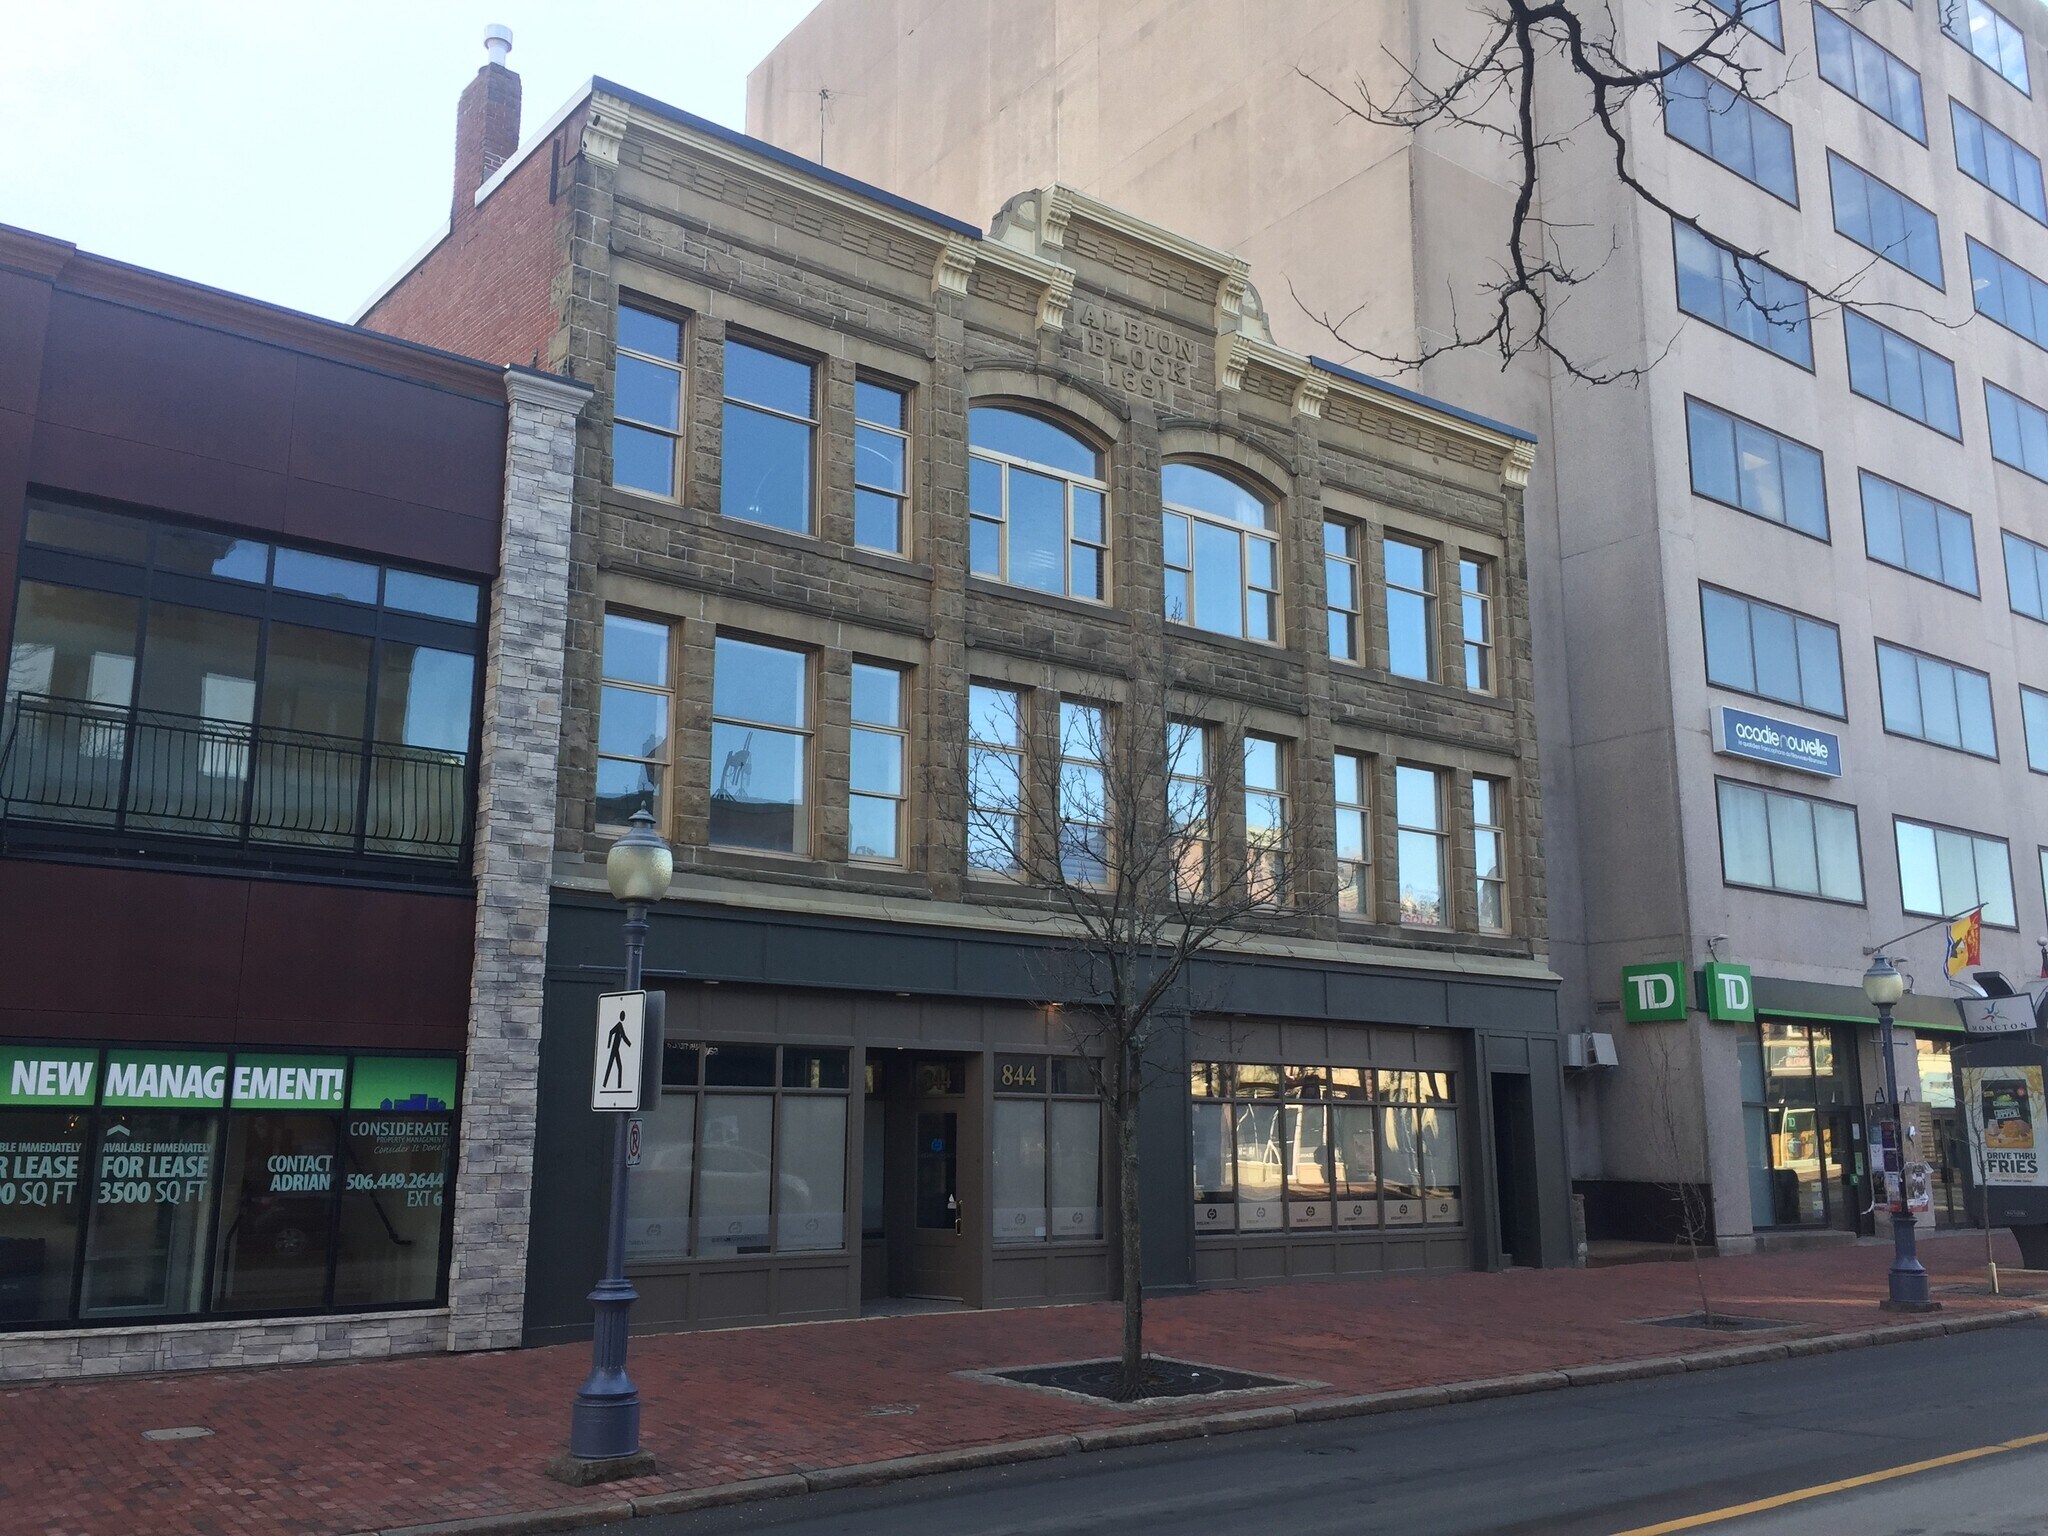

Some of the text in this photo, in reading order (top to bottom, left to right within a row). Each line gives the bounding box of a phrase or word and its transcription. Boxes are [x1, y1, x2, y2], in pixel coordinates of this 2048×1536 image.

[1080, 304, 1194, 363] ALBION
[1088, 331, 1186, 385] BLOCK
[1108, 363, 1167, 400] 1891
[1628, 973, 1675, 1010] TD
[1717, 973, 1749, 1010] TD
[1971, 1022, 2028, 1032] MONCTON
[11, 1060, 94, 1096] NEW
[1001, 1064, 1037, 1086] 844
[350, 1121, 449, 1136] CONSIDERATE
[18, 1142, 82, 1153] IMMEDIATELY
[102, 1142, 211, 1153] AVAILABLE IMMEDIATELY
[1986, 1152, 2037, 1160] DRIVE THRU
[13, 1155, 80, 1179] LEASE
[101, 1155, 209, 1178] FOR LEASE
[267, 1154, 333, 1173] CONTACT
[1988, 1160, 2039, 1173] FRIES
[269, 1173, 331, 1192] ADRIAN
[345, 1172, 444, 1190] 506.449.2644
[19, 1181, 48, 1207] SQ
[52, 1181, 77, 1204] FT
[98, 1180, 208, 1205] 3500 SQ FT
[407, 1190, 443, 1207] EXT 6
